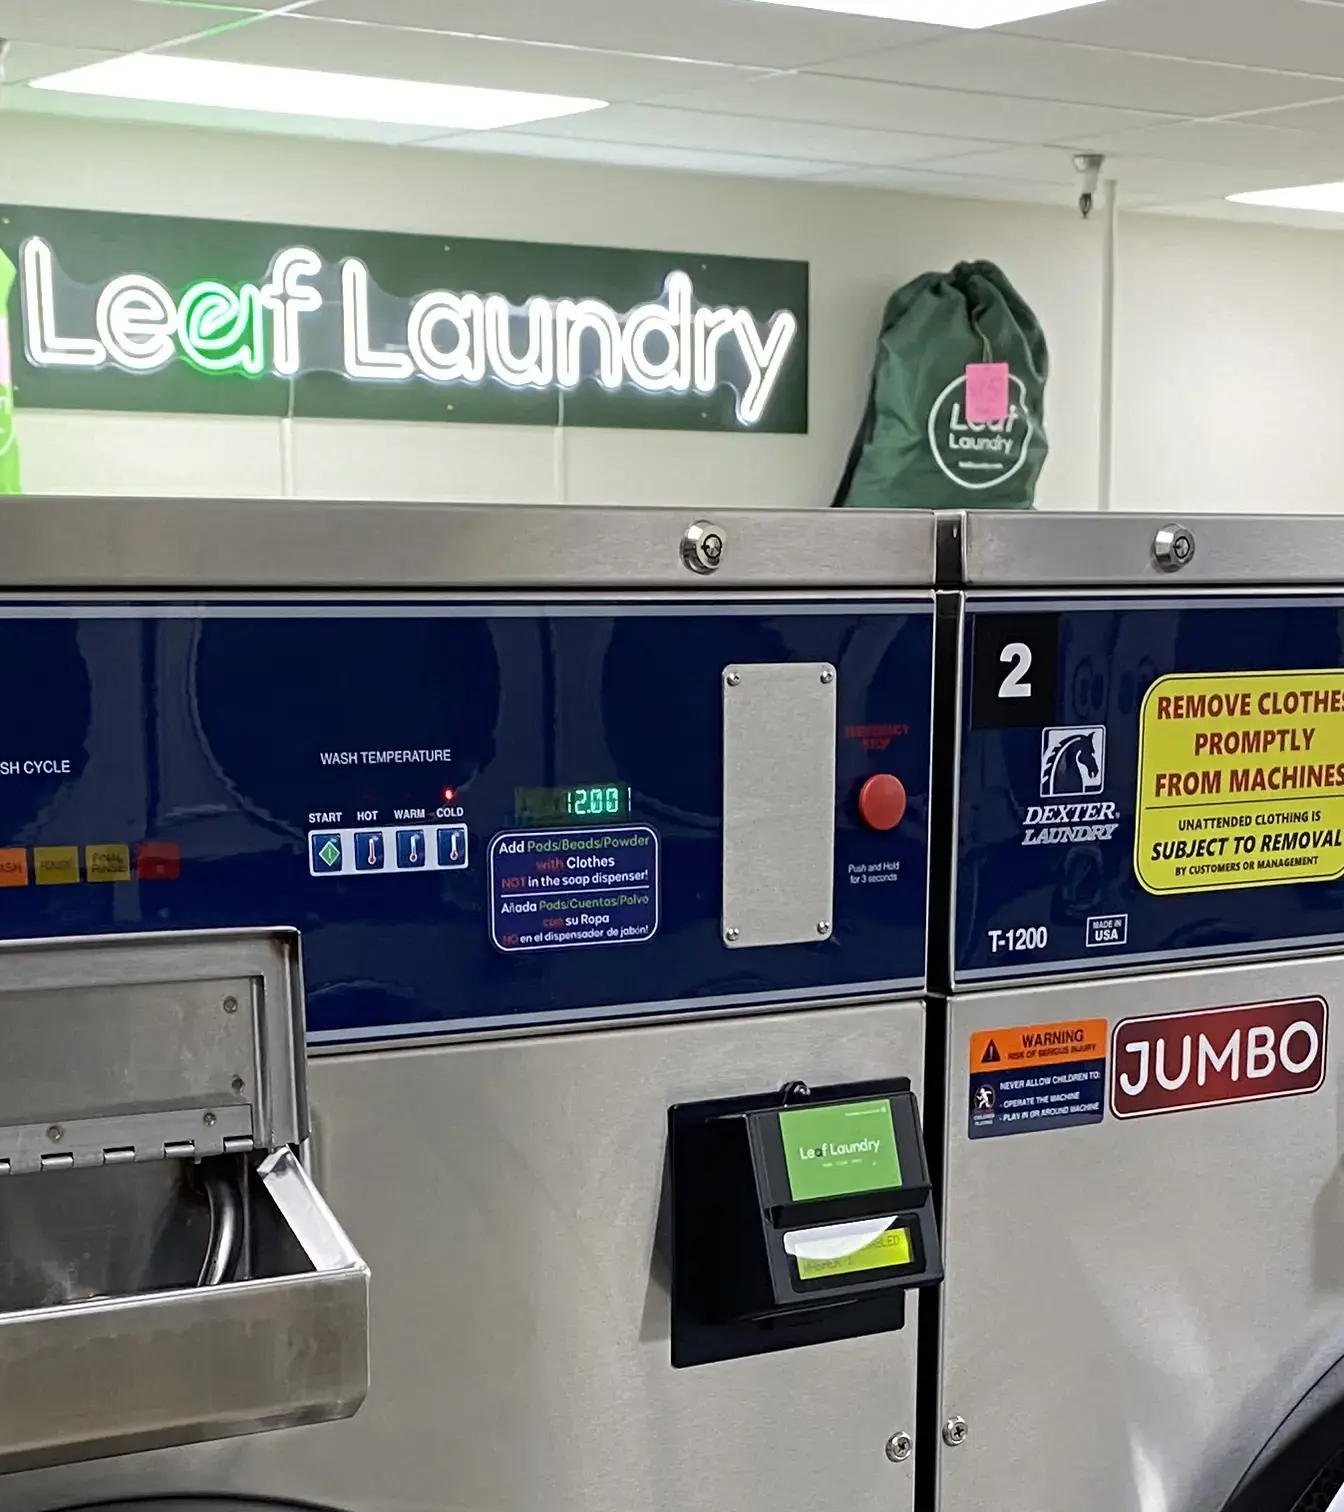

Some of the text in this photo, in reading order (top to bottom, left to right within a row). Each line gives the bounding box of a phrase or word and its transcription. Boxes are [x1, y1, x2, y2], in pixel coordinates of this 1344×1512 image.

[20, 238, 795, 424] Leaf Laundry
[949, 433, 1013, 454] Laundry
[998, 642, 1032, 697] 2
[1157, 692, 1252, 720] REMOVE
[1194, 727, 1316, 757] PROMPTLY
[23, 759, 71, 775] CYCLE
[319, 748, 452, 765] WASH TEMPERATURE
[1155, 769, 1222, 798] FROM
[568, 788, 618, 814] 12.00
[309, 807, 463, 823] START HOT WARM COLD
[1178, 810, 1321, 832] UNATTENDED CLOTHING IS
[1022, 823, 1119, 846] LAUNDRY
[1150, 828, 1342, 861] SUBJECT TO REMOVAL
[499, 842, 524, 854] Add
[567, 856, 615, 869] Clothes
[848, 862, 899, 874] Push and Hold
[1175, 855, 1319, 877] BY CUSTOMERS OR MANAGEMENT
[528, 870, 648, 887] in the soap dispenser!
[501, 902, 537, 913] Añada
[565, 914, 609, 926] su Ropa
[520, 934, 532, 943] en
[534, 933, 543, 942] el
[545, 930, 603, 942] dispensador
[607, 928, 618, 936] de
[988, 926, 1047, 951] T-1200
[1095, 930, 1118, 942] USA
[1022, 1029, 1084, 1048] WARNING
[1120, 1021, 1319, 1096] JUMBO
[800, 1139, 880, 1160] Leaf Laundry
